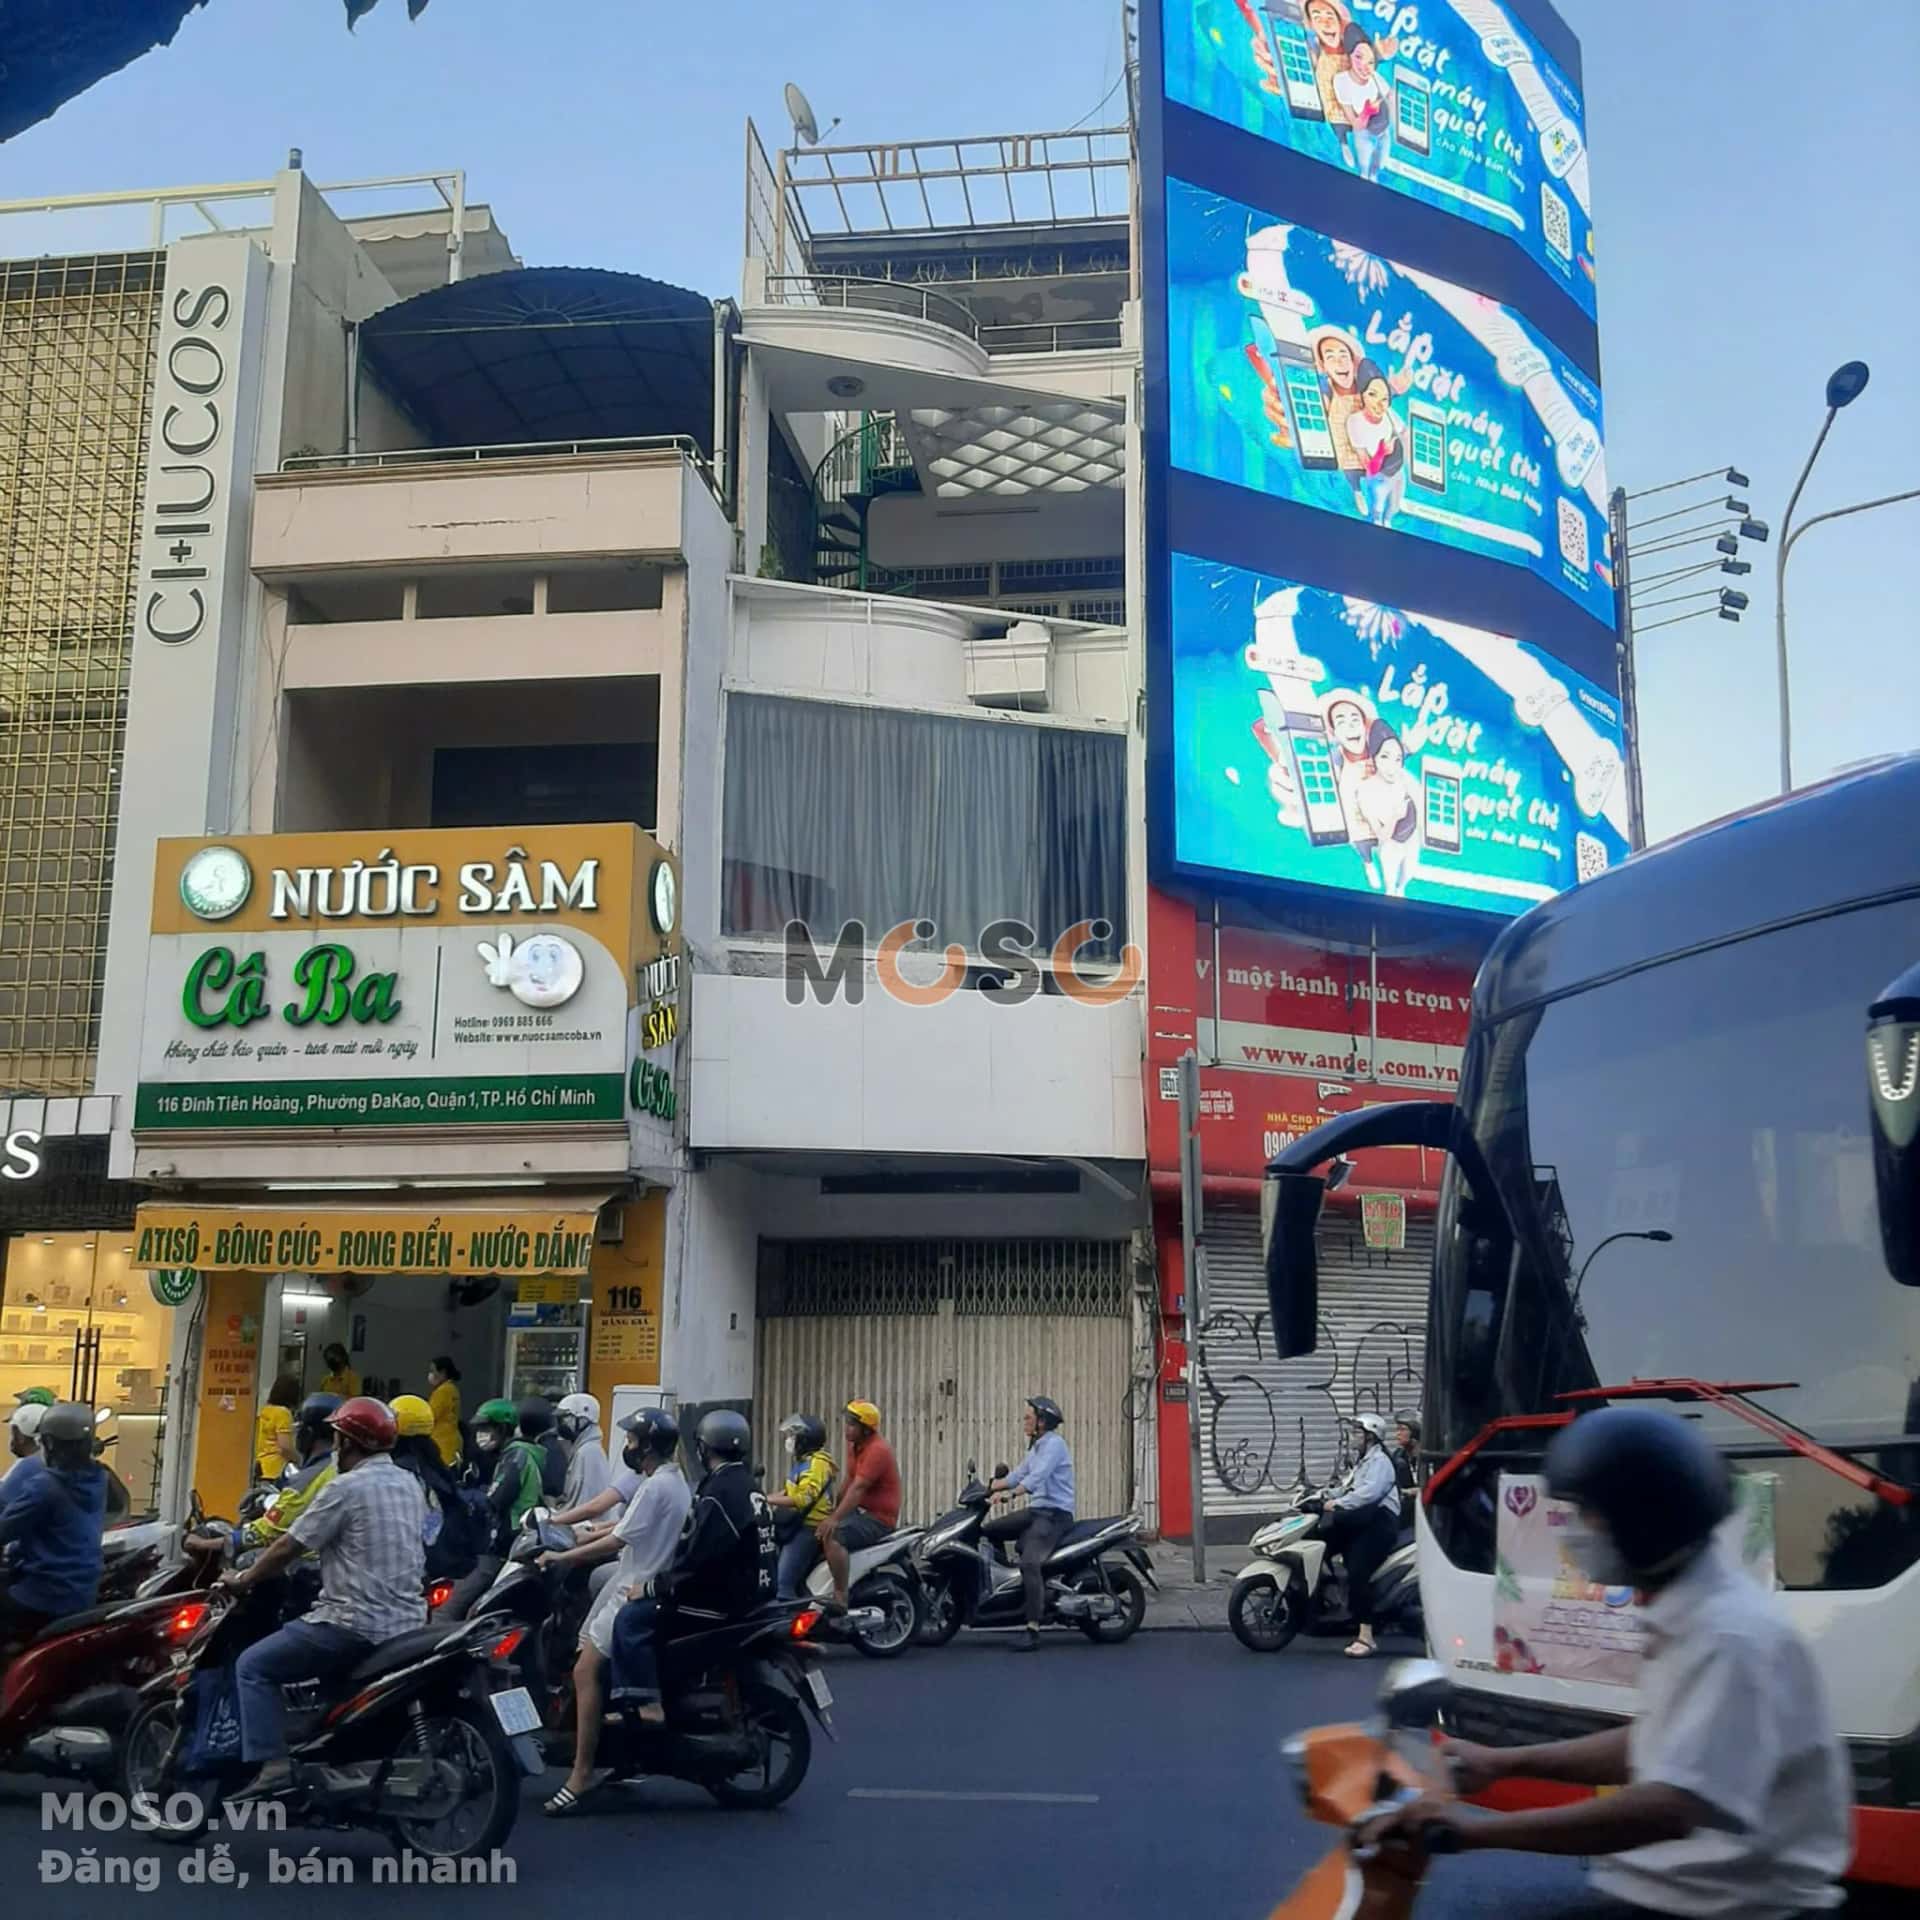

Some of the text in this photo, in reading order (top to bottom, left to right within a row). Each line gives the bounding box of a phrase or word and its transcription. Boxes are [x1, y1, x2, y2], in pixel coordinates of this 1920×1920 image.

[1399, 35, 1451, 74] đặt
[1432, 78, 1487, 121] máy
[1433, 108, 1488, 142] quẹt
[1365, 310, 1434, 365] Lắp
[1413, 361, 1467, 405] đặt
[1446, 407, 1503, 449] máy
[1448, 438, 1505, 471] quẹt
[1377, 664, 1448, 736] Lắp
[1429, 713, 1483, 755] đặt
[1463, 758, 1521, 798] máy
[269, 846, 600, 919] NƯỚC SÂM
[181, 942, 404, 1029] Cô Ba
[1227, 965, 1275, 991] một
[1280, 970, 1339, 997] hạnh
[1404, 988, 1453, 1013] trọn
[454, 1030, 602, 1044] Website: www.nuocsamcoba.vn
[492, 1016, 515, 1028] 0969
[535, 1015, 553, 1027] 666
[157, 1096, 178, 1113] 116
[217, 1095, 248, 1112] Tiên
[252, 1094, 304, 1115] Hoàng,
[531, 1085, 556, 1105] Chí
[560, 1089, 596, 1105] Minh
[1290, 1114, 1313, 1125] CHO
[137, 1216, 594, 1269] ATISÔ BÔNG CÚC RONG BIỂN NƯỚC ĐẮNG
[607, 1285, 643, 1309] 116
